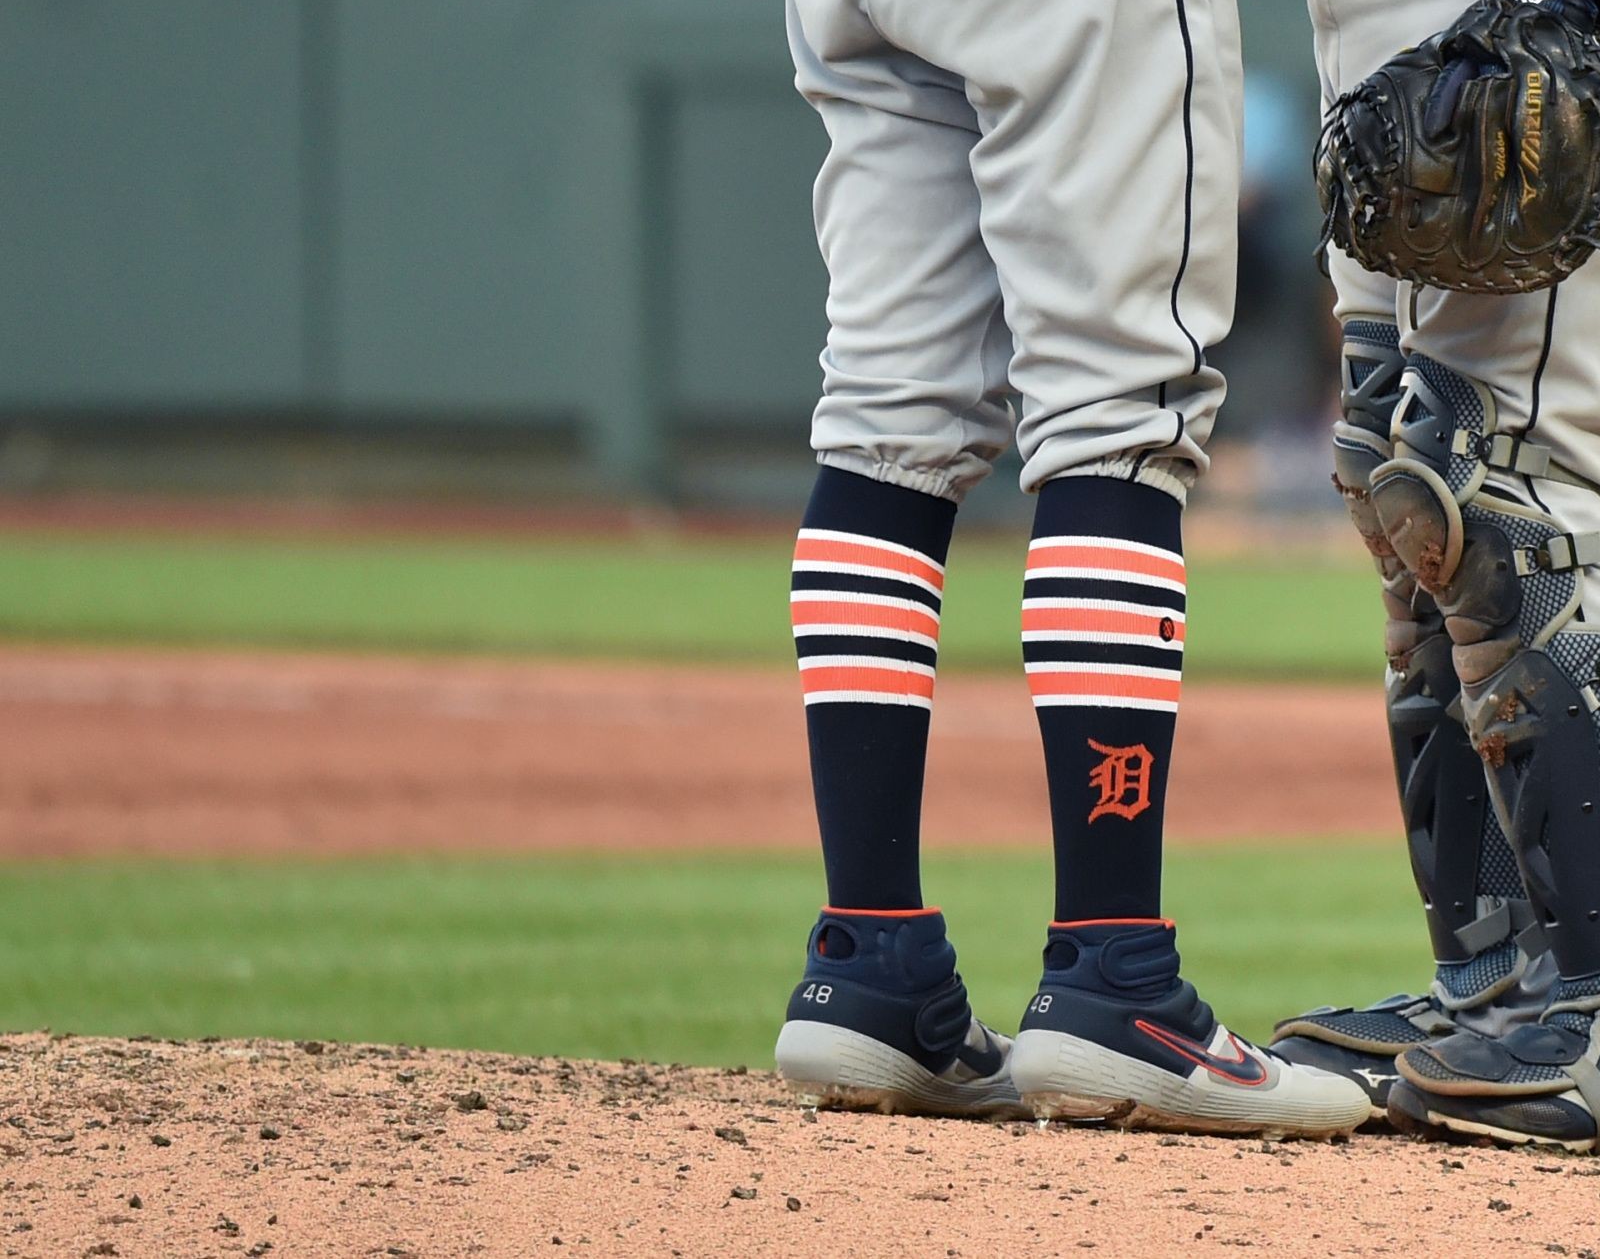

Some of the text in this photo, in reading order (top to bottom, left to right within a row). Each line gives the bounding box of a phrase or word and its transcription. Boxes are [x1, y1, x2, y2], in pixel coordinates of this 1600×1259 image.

[1087, 737, 1155, 825] D
[802, 983, 833, 1004] 48
[1030, 994, 1053, 1013] 48
